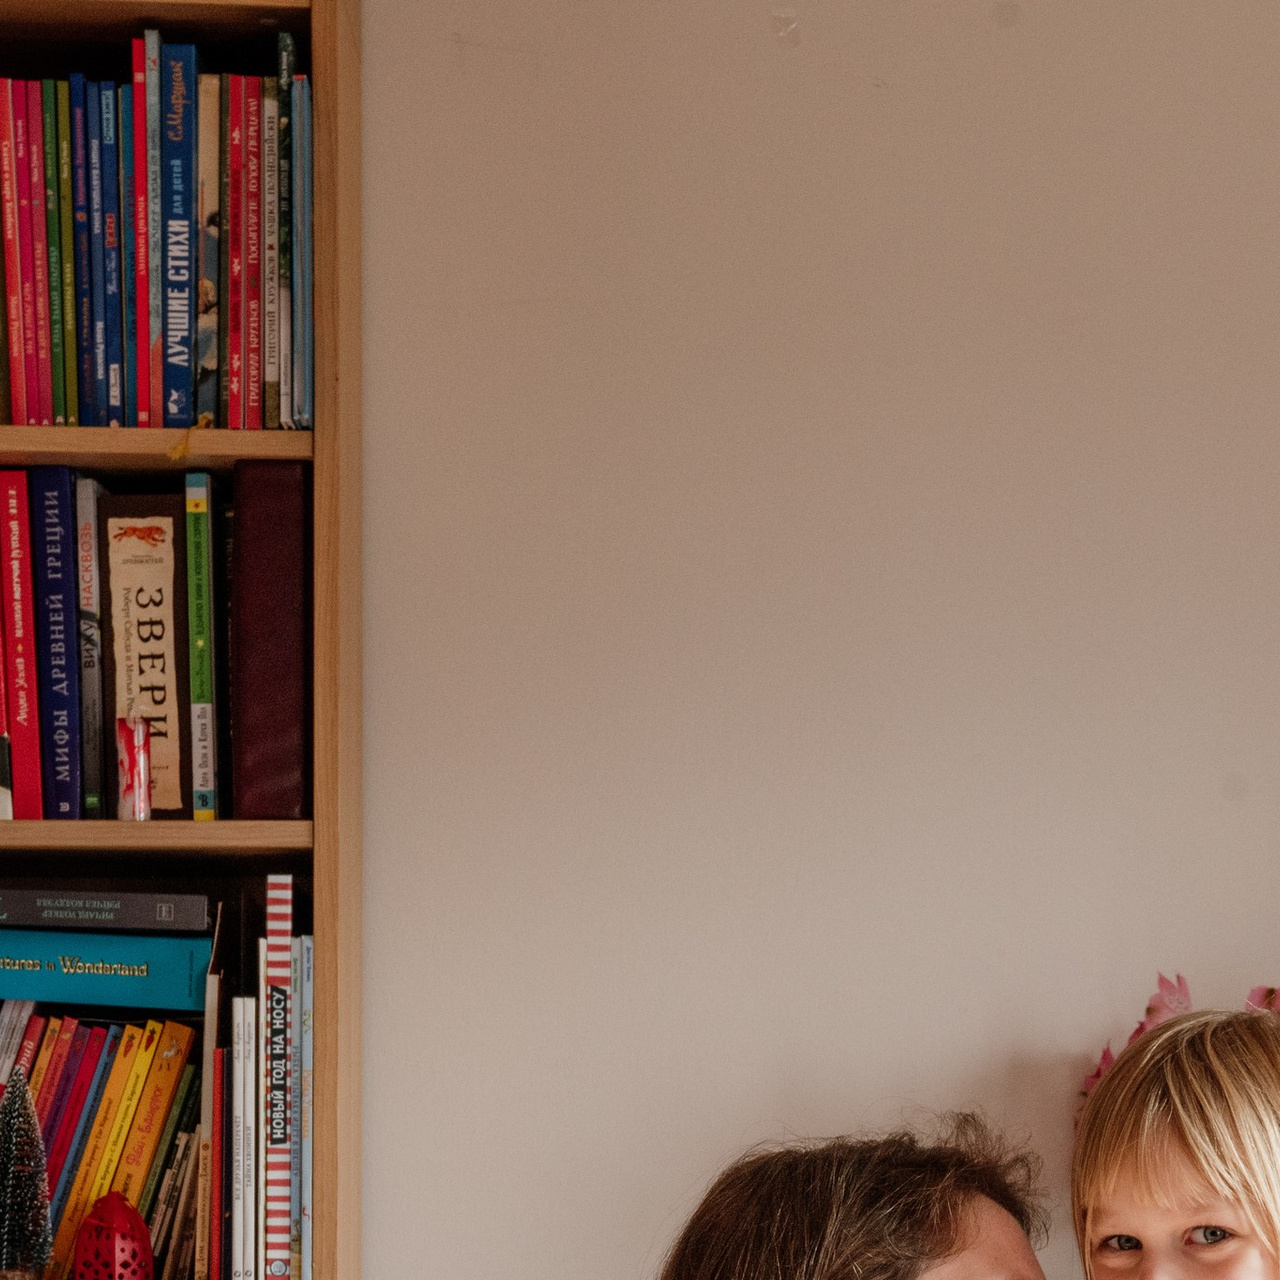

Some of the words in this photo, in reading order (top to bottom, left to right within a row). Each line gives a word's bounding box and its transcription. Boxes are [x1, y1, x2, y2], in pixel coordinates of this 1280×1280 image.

[168, 218, 190, 282] СТИХИ
[265, 254, 276, 305] КРУЖКОВ
[168, 287, 190, 367] ЛУЧШИЕ
[265, 310, 277, 366] ГРИГОРИЙ
[43, 489, 65, 580] ГРЕЦИИ
[79, 521, 95, 608] НАСКВОЗЬ
[121, 586, 134, 619] Роберт
[45, 593, 70, 697] ДРЕВНЕЙ
[80, 619, 97, 669] ВИЖУ
[134, 586, 170, 739] ЗВЕРИ
[53, 709, 71, 782] МИФЫ
[59, 955, 149, 978] Wonderland
[271, 991, 285, 1029] НОСУ
[272, 1034, 285, 1054] НА
[271, 1058, 286, 1085] ГОД
[269, 1089, 286, 1139] НОВЫЙ
